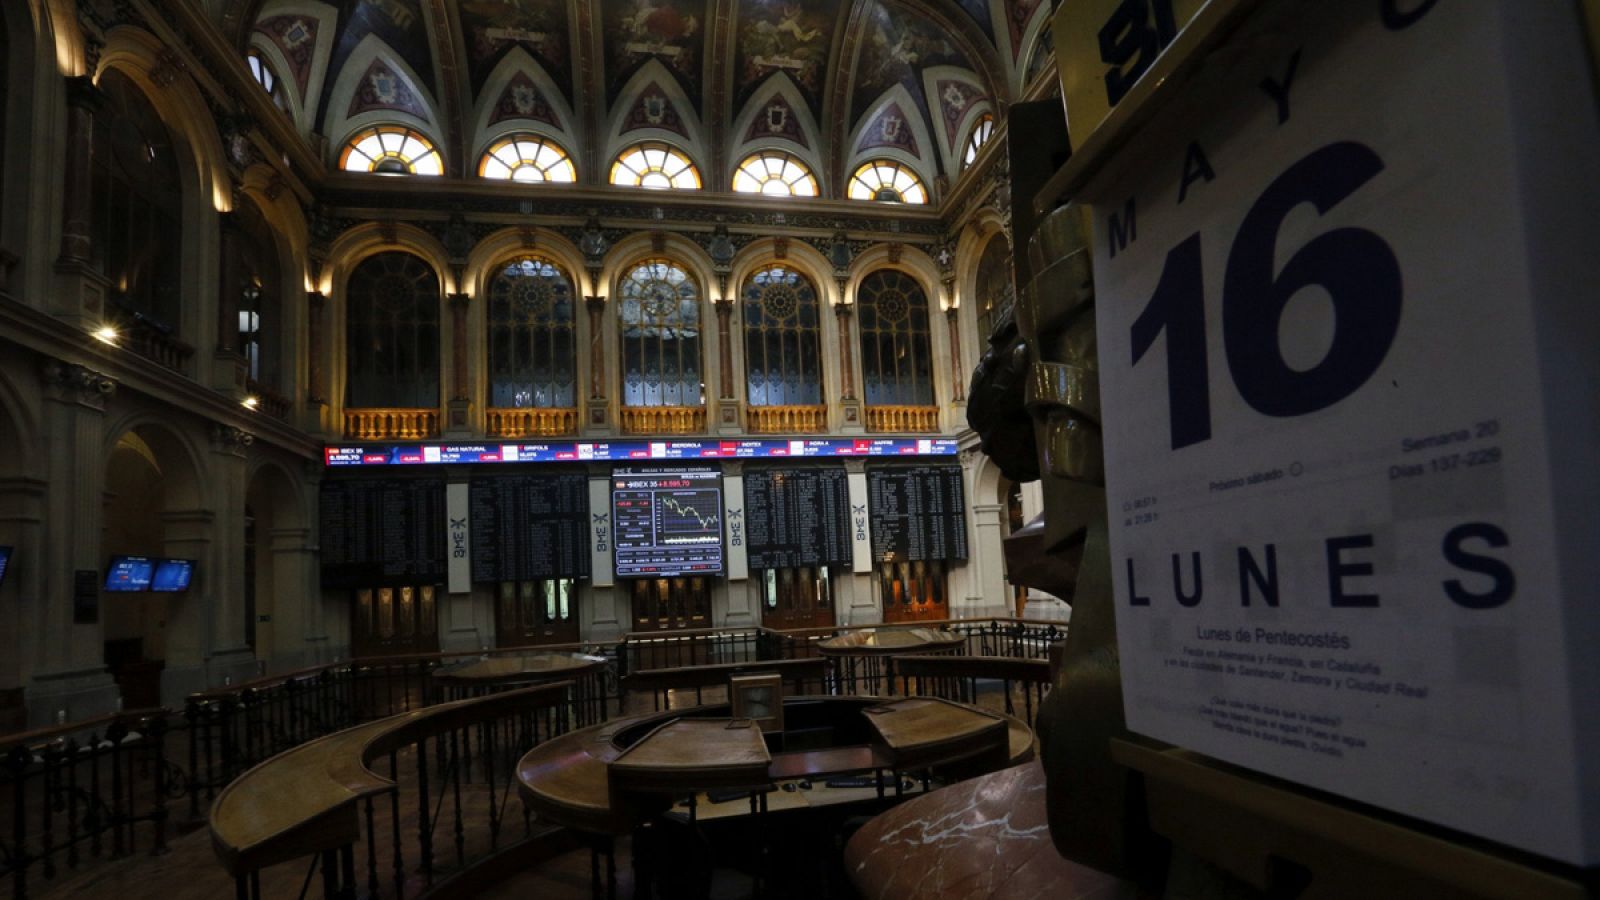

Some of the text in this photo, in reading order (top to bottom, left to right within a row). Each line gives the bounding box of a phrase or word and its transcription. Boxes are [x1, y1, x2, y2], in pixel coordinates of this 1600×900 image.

[1130, 141, 1404, 452] 16
[1401, 419, 1500, 453] Semana 20
[1208, 478, 1245, 492] Próximo
[1127, 522, 1517, 609] LUNES
[1197, 626, 1351, 650] Lunes de Pentecostés
[1218, 650, 1256, 662] Alemania
[1310, 658, 1324, 669] en
[1327, 659, 1381, 676] Cataluña
[1226, 664, 1236, 674] de
[1290, 671, 1332, 687] Zamora
[1346, 678, 1390, 694] Ciudad
[1396, 682, 1429, 700] Real
